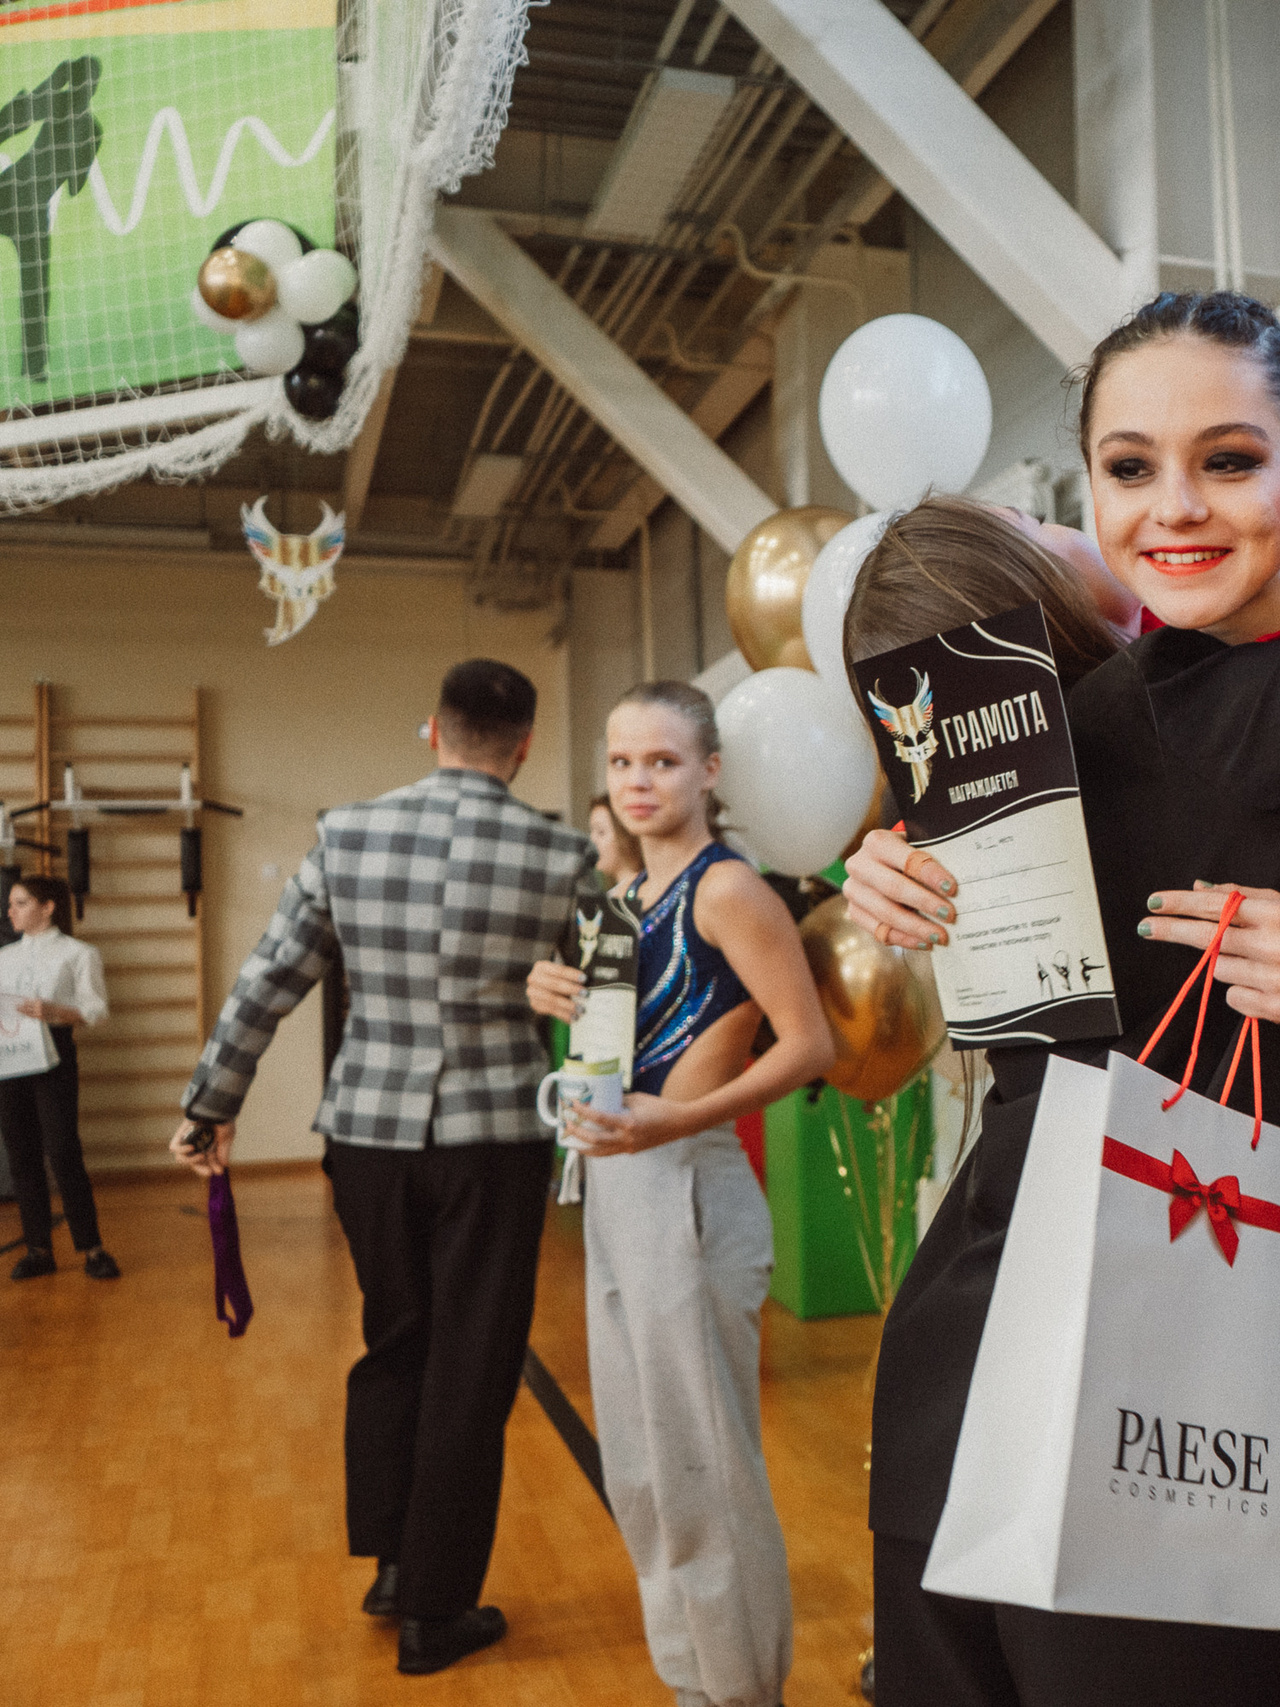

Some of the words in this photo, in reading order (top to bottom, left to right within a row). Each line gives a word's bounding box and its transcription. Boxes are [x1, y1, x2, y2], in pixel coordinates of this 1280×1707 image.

[940, 690, 1049, 759] ГРАМОТА
[948, 769, 1019, 805] НАГРАЖДАЕТСЯ
[1112, 1407, 1269, 1494] PAESE
[1109, 1478, 1268, 1517] COSMETICS
